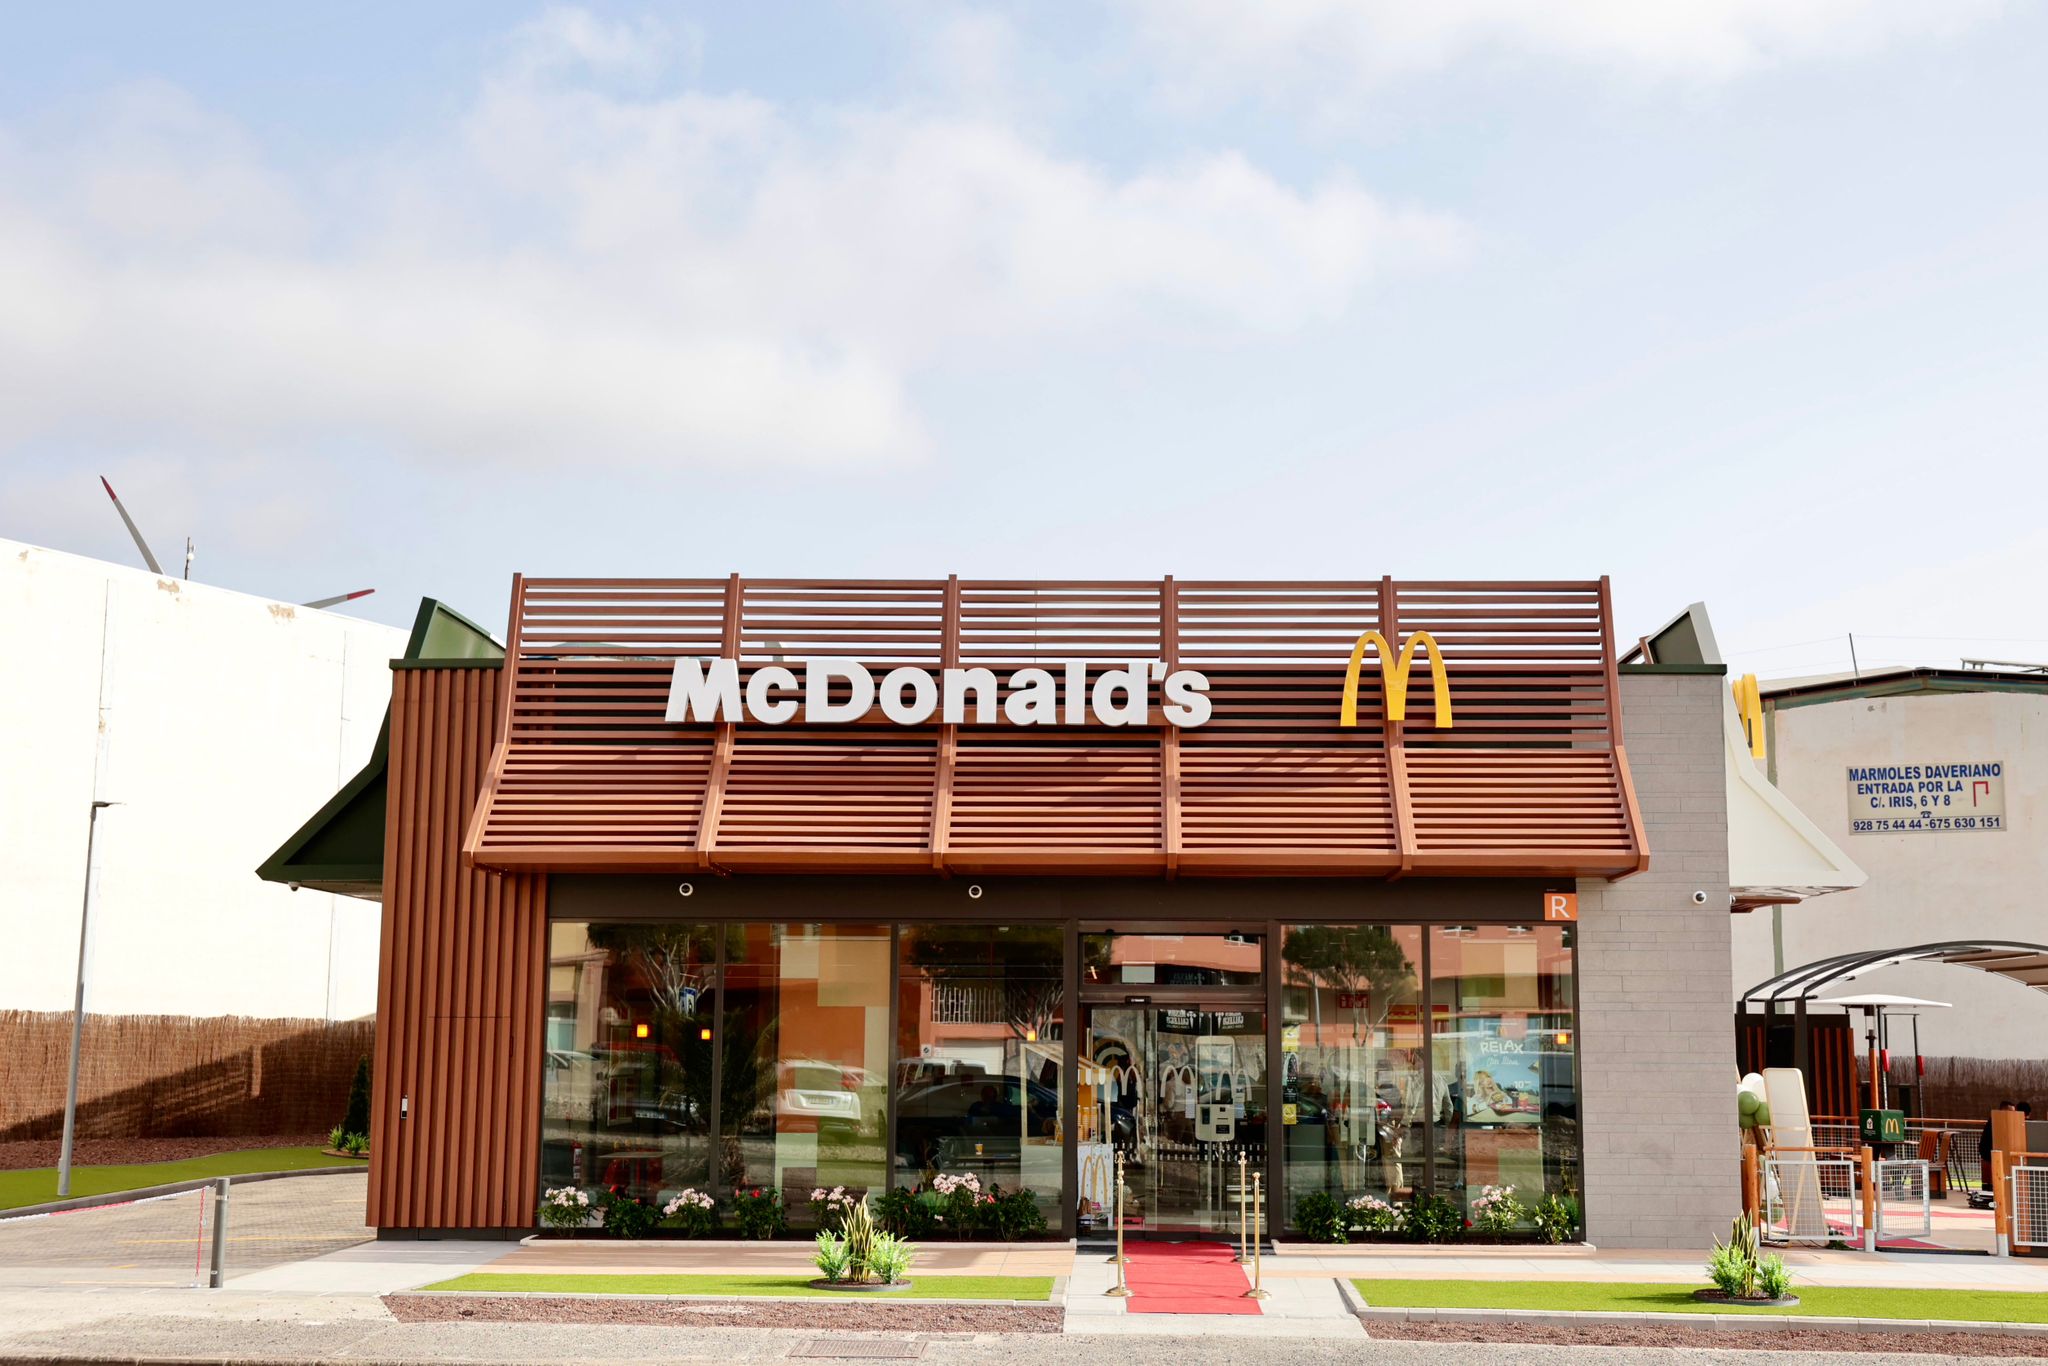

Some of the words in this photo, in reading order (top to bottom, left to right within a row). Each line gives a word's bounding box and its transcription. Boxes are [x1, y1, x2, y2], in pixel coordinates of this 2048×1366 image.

[664, 657, 1213, 729] McDonald's
[1849, 766, 1921, 781] MARMOLES
[1925, 763, 2001, 779] DAVERIANO
[1857, 782, 1914, 795] ENTRADA
[1918, 781, 1943, 793] POR
[1947, 780, 1963, 792] LA
[1889, 795, 1917, 809] IRIS,
[1920, 795, 1928, 807] 6
[1931, 795, 1940, 807] Y
[1943, 794, 1951, 806] 8
[1853, 820, 1873, 831] 928
[1876, 820, 1889, 830] 75
[1892, 820, 1906, 830] 44
[1908, 819, 1922, 829] 44
[1954, 818, 1976, 828] 630
[1980, 817, 2000, 827] 151
[1551, 895, 1570, 919] R
[1480, 1040, 1524, 1055] RELAX
